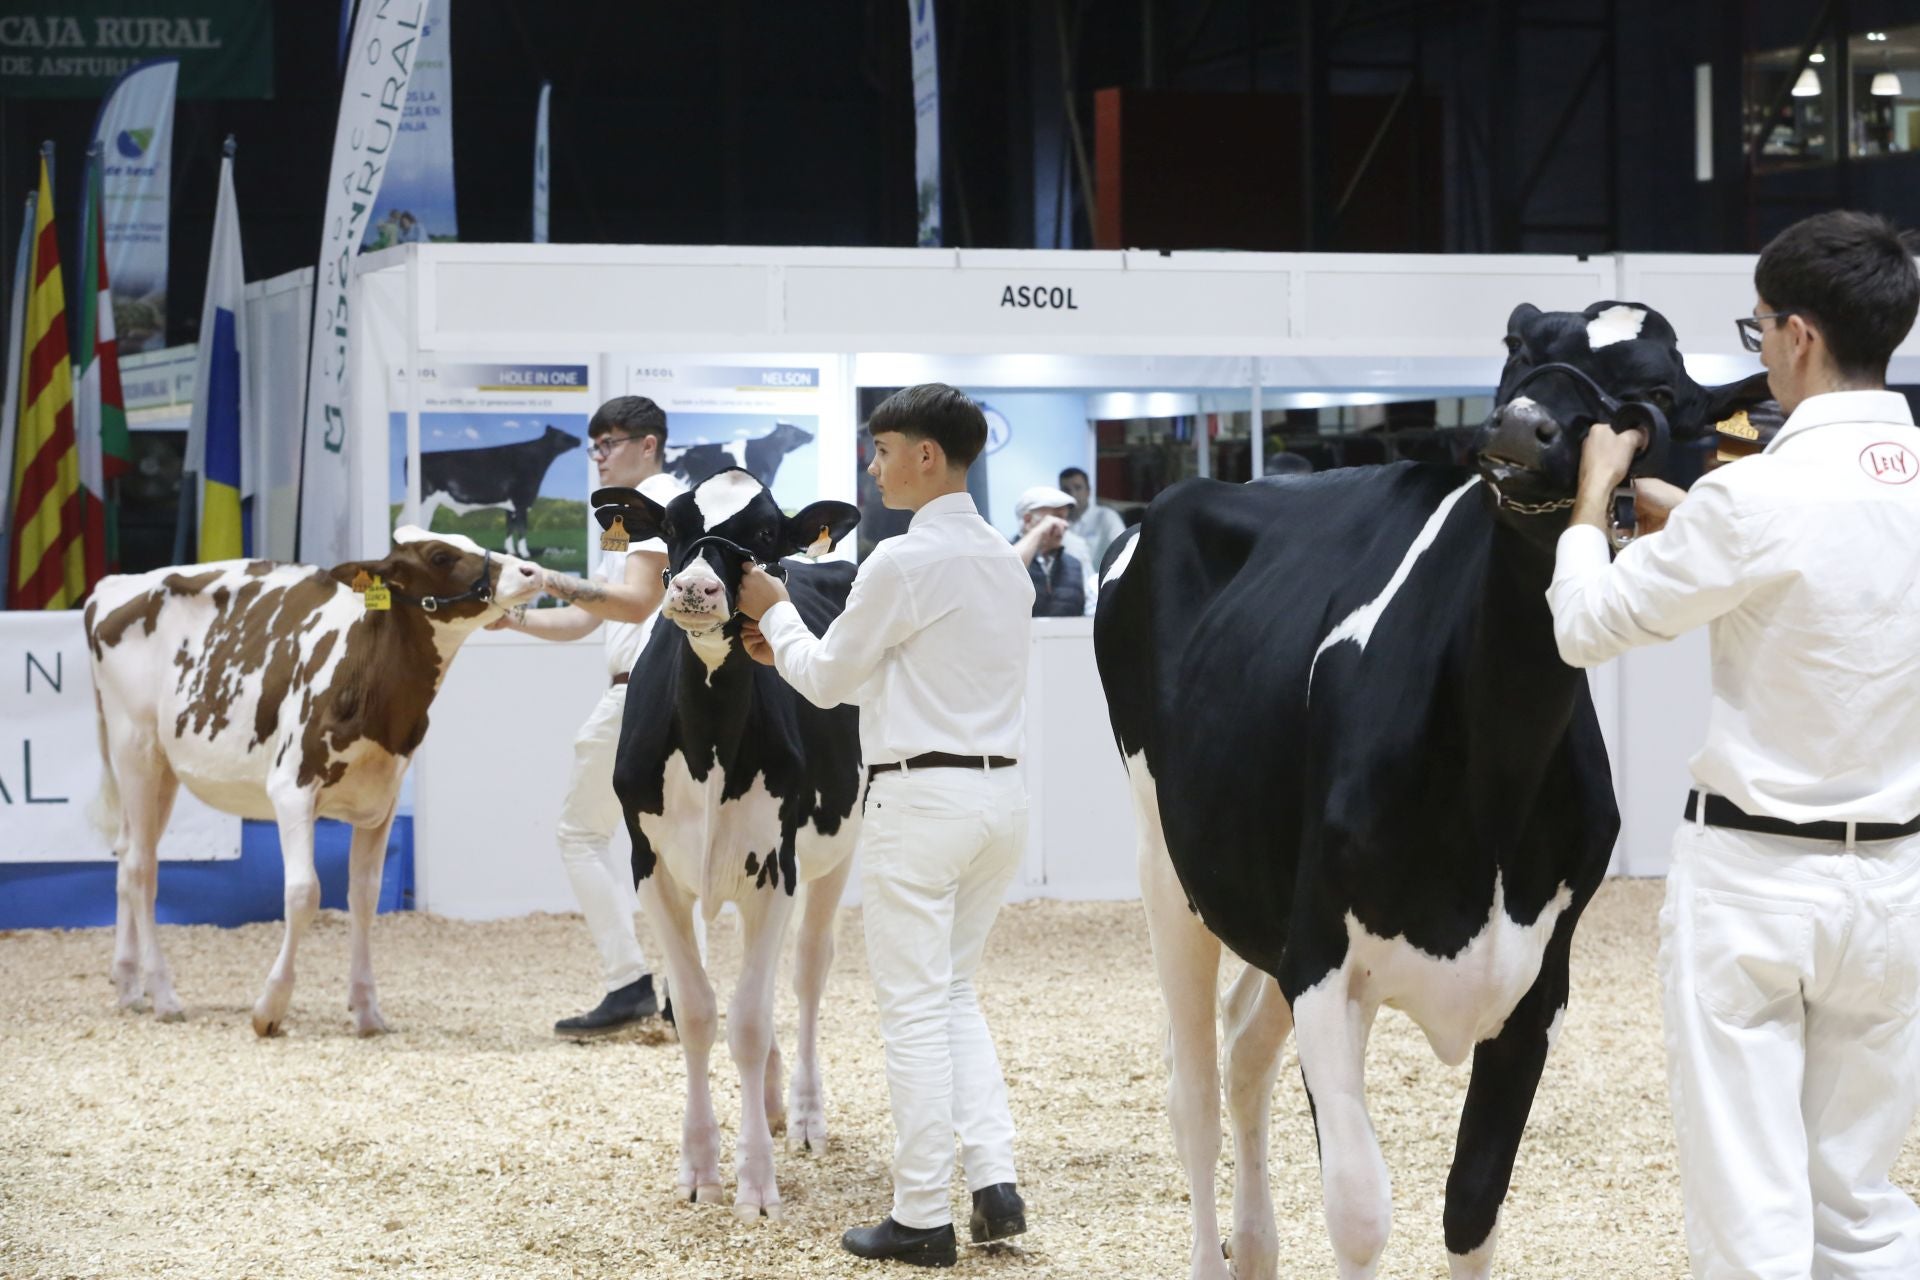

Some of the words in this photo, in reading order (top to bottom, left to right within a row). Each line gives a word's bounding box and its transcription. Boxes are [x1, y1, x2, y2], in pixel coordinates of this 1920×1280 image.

[0, 17, 86, 48] CAJA
[96, 18, 222, 48] RURAL
[1, 57, 34, 75] DE
[1000, 285, 1079, 309] ASCOL
[500, 371, 533, 384] HOLE
[535, 371, 549, 385] IN
[551, 371, 578, 385] ONE
[635, 368, 675, 378] ASCOL
[762, 371, 811, 385] NELSON
